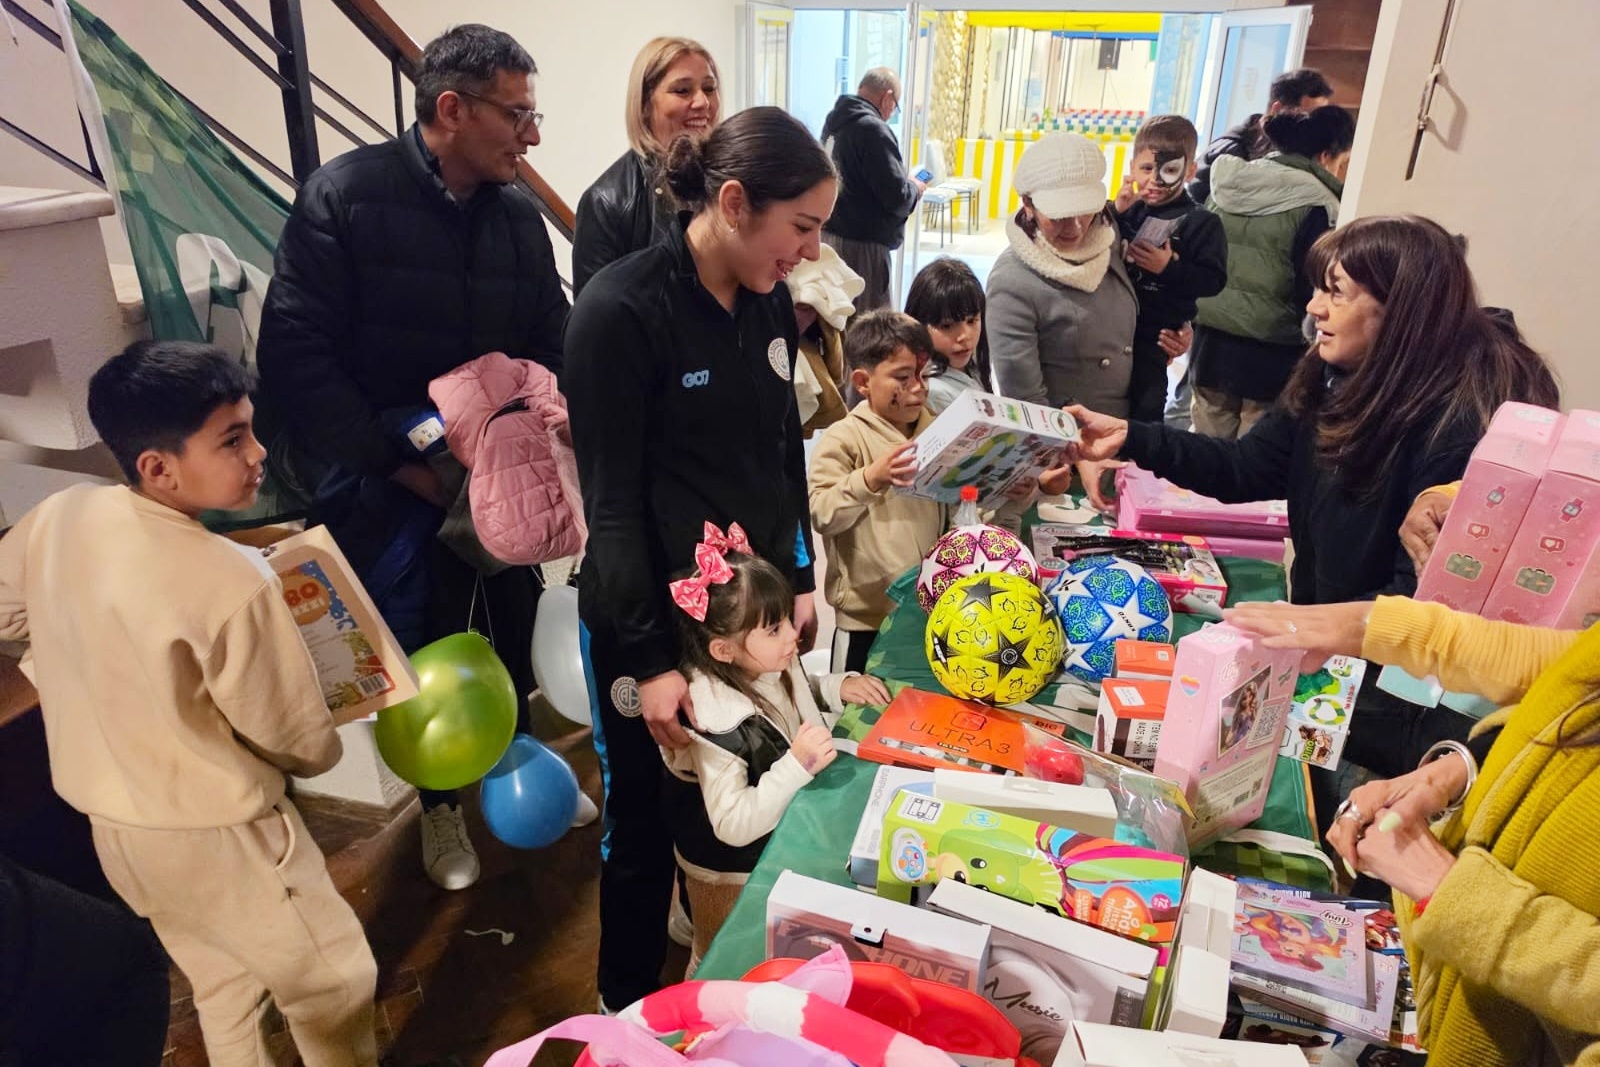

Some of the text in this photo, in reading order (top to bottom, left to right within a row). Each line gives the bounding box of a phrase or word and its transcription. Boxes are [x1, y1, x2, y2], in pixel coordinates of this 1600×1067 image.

[1300, 740, 1315, 760] Dino
[871, 767, 891, 807] EARPHONE
[983, 976, 1064, 1022] Music
